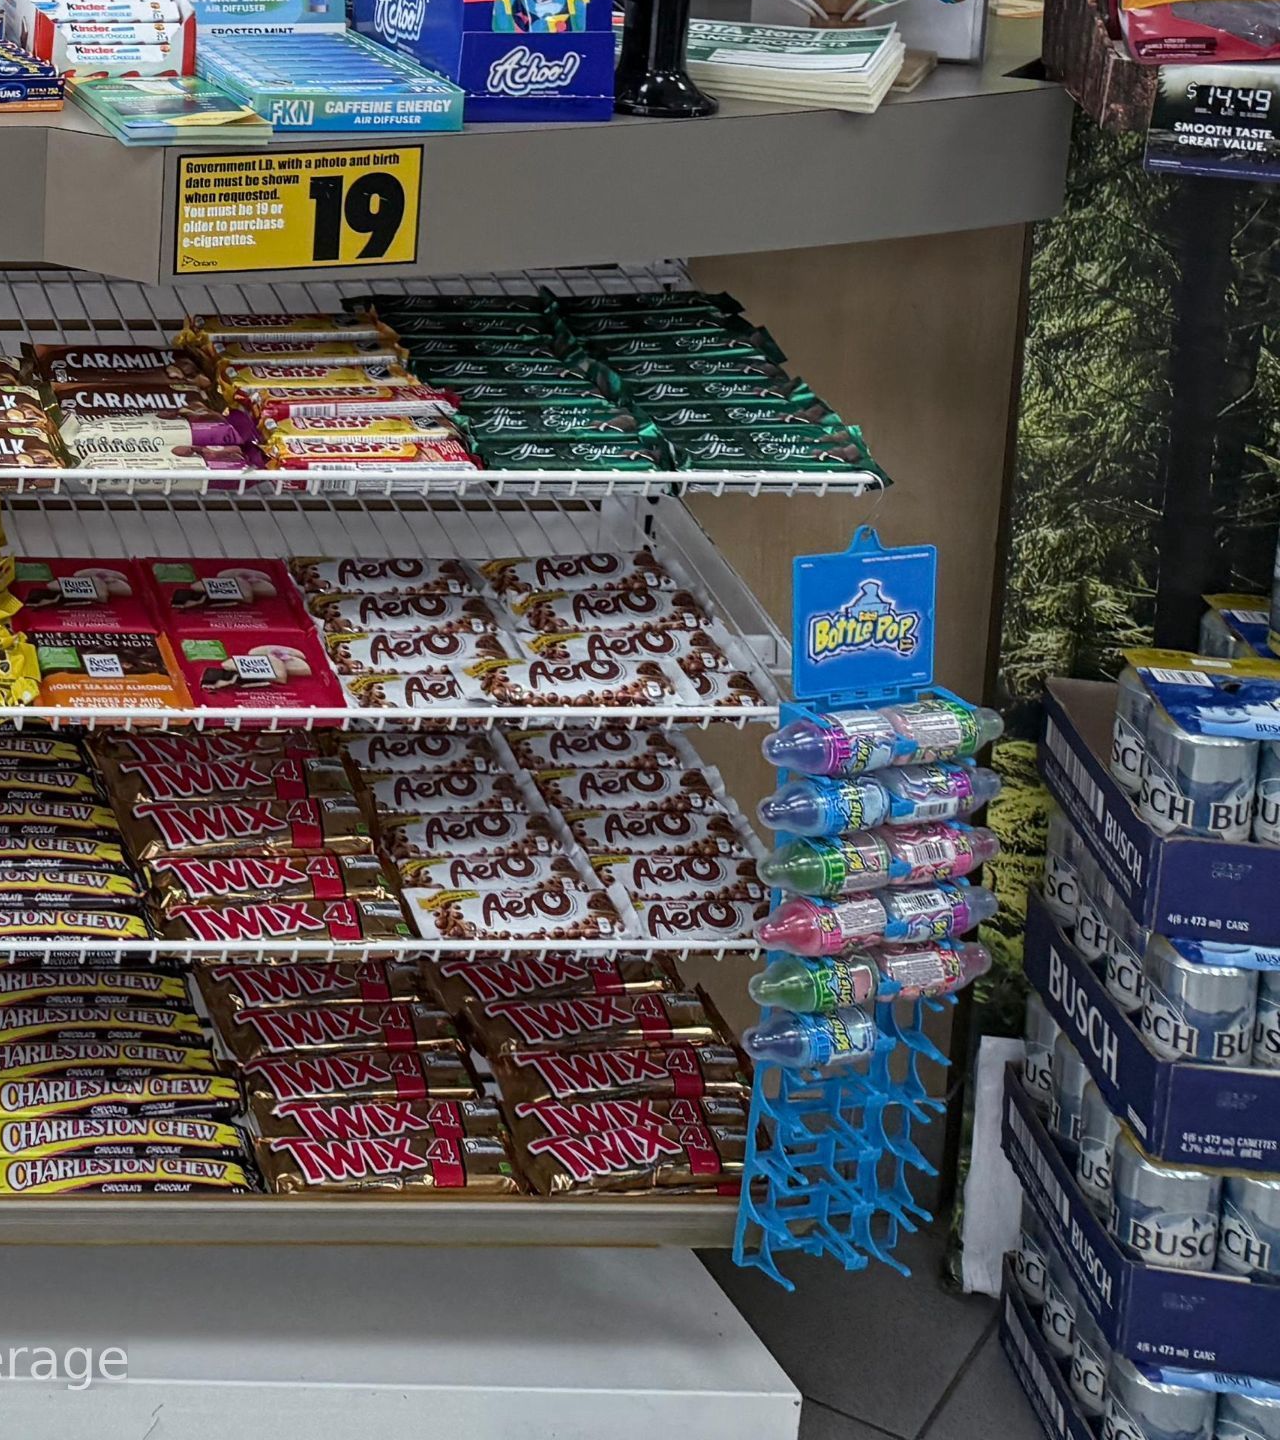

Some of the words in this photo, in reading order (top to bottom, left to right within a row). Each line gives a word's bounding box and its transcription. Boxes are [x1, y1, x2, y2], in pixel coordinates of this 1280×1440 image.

[271, 100, 313, 125] FKN
[325, 101, 389, 114] CAFFEINE
[393, 100, 451, 113] ENERGY
[354, 116, 374, 124] AIR
[377, 116, 421, 124] DIFFUSER
[1173, 122, 1232, 136] SMOOTH
[1235, 126, 1275, 140] TASTE.
[1178, 135, 1220, 148] GREAT
[1224, 137, 1267, 151] VALUE.
[186, 161, 256, 174] Government
[259, 160, 275, 171] I.D.
[278, 159, 302, 169] with
[305, 160, 312, 169] a
[315, 156, 346, 169] photo
[349, 155, 370, 166] and
[373, 153, 399, 165] birth
[186, 177, 211, 189] date
[214, 177, 242, 187] must
[245, 175, 259, 186] be
[262, 174, 300, 186] shown
[185, 193, 216, 204] when
[219, 190, 279, 203] requested.
[184, 206, 205, 219] You
[208, 205, 237, 216] must
[239, 204, 253, 215] be
[255, 203, 268, 215] 19
[270, 203, 283, 214] or
[309, 172, 405, 261] 19
[183, 221, 213, 233] older
[216, 220, 227, 231] to
[230, 218, 284, 233] purchase
[183, 234, 256, 248] e-cigarettes.
[494, 444, 555, 458] After
[572, 444, 620, 460] Eight
[1104, 810, 1142, 883] BUSCH
[62, 912, 129, 931] CHEW
[168, 901, 326, 941] TWIX
